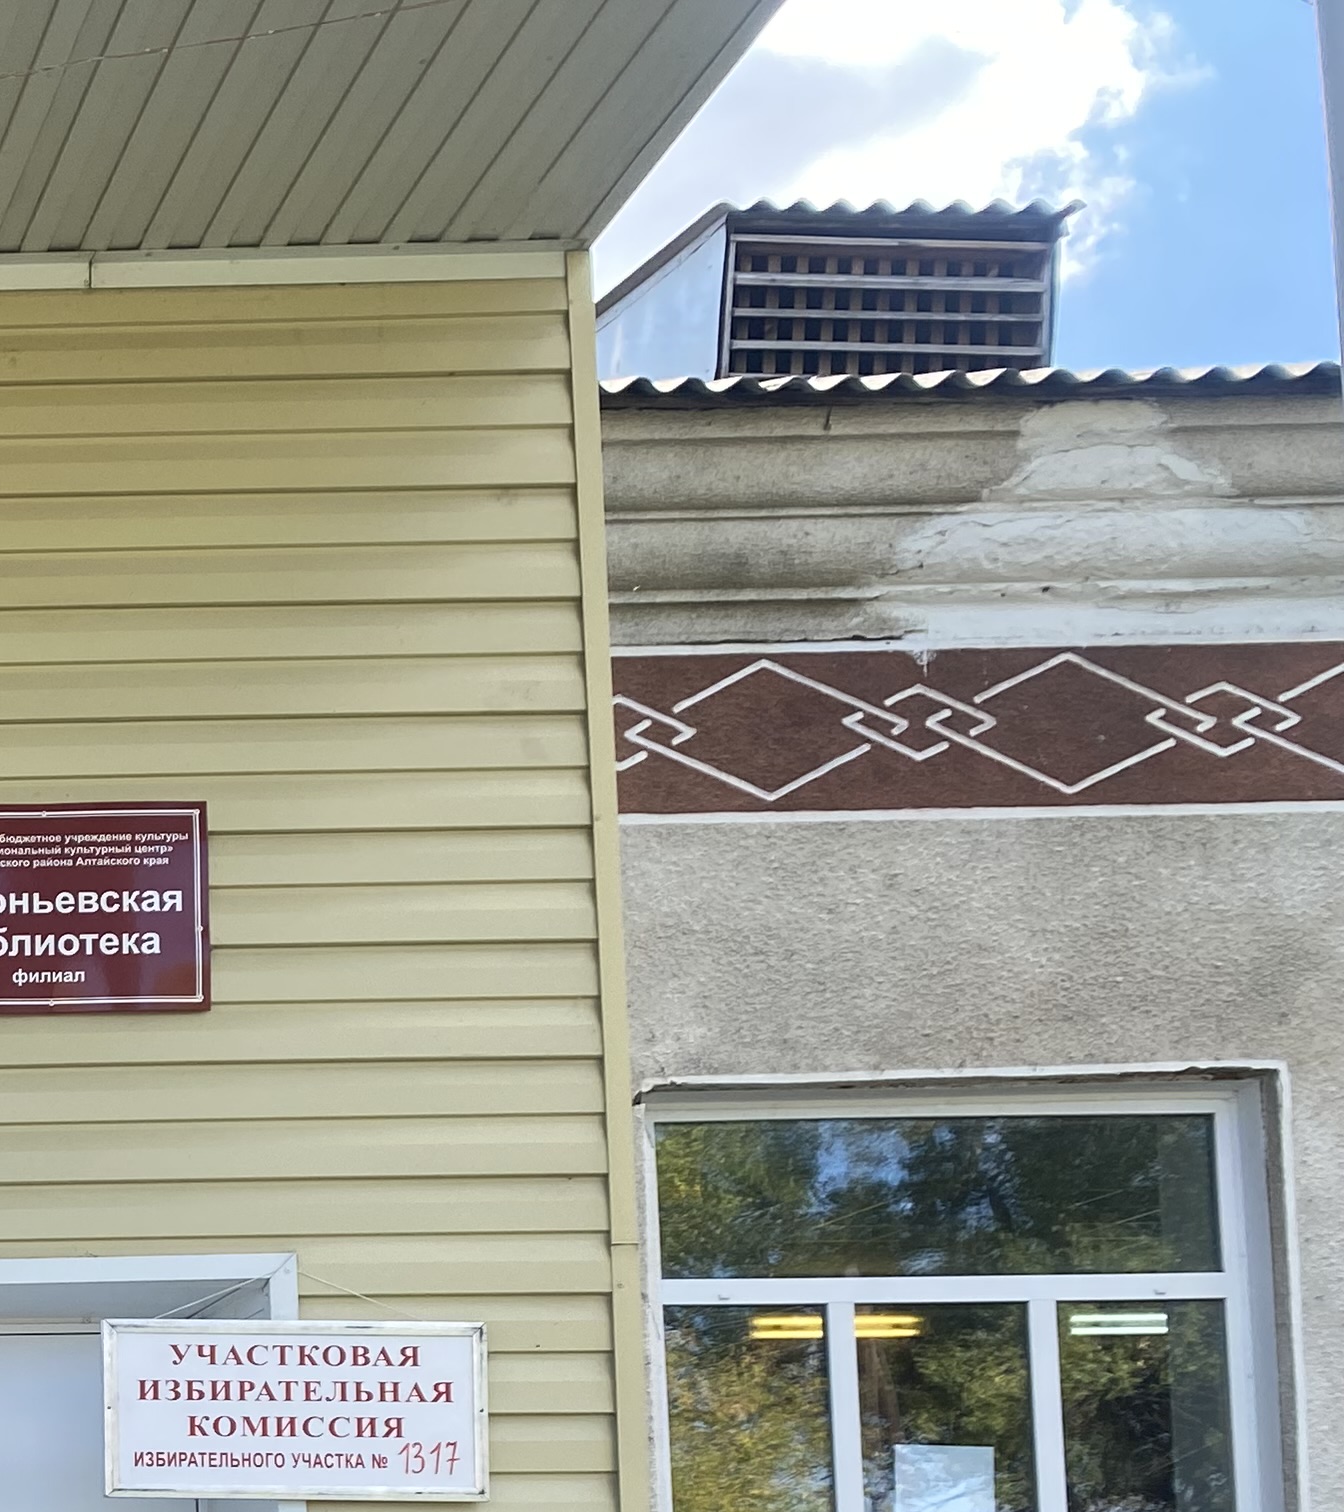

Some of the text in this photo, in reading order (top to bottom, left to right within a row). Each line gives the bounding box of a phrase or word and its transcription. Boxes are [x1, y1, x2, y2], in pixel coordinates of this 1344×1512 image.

[0, 834, 61, 845] бюджетное
[64, 832, 133, 844] учреждение
[135, 831, 189, 842] культуры
[64, 844, 132, 855] культурный
[134, 844, 174, 854] центр»
[33, 857, 73, 868] района
[76, 856, 141, 867] Алтайского
[143, 856, 169, 867] края
[12, 969, 85, 986] филиал
[170, 1343, 421, 1367] УЧАСТКОВАЯ
[137, 1378, 454, 1404] ИЗБИРАТЕЛЬНАЯ
[186, 1414, 406, 1438] КОМИССИЯ
[134, 1440, 460, 1476] ИЗБИРАТЕЛЬНОГО УЧАСТКА № 1317
